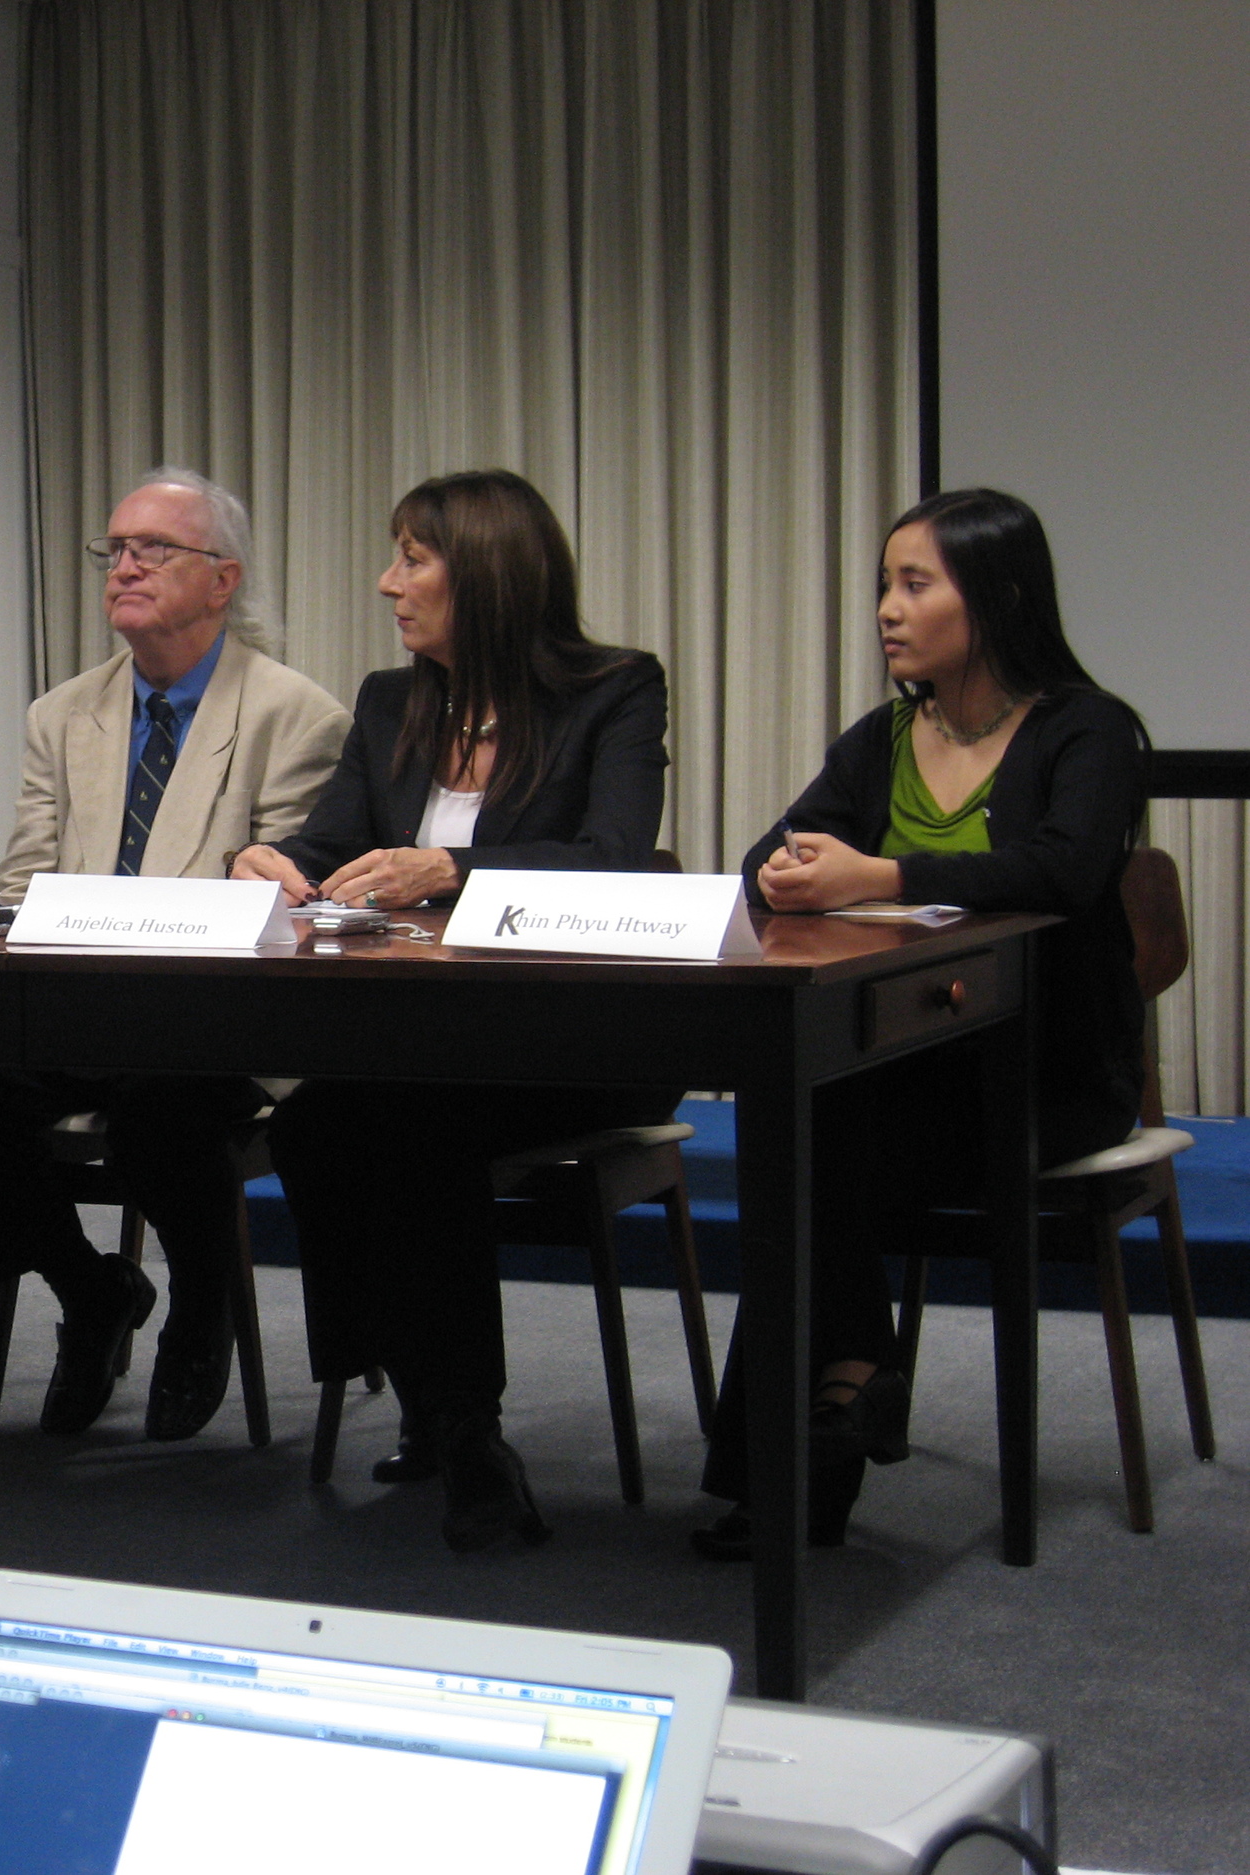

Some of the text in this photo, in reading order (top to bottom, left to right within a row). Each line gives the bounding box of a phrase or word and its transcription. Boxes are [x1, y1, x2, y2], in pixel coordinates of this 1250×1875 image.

[55, 915, 209, 935] Anjelica Huston
[494, 905, 688, 939] Khin Phyu Htway
[13, 1627, 258, 1666] QuickTime Player File Edit View Window Help
